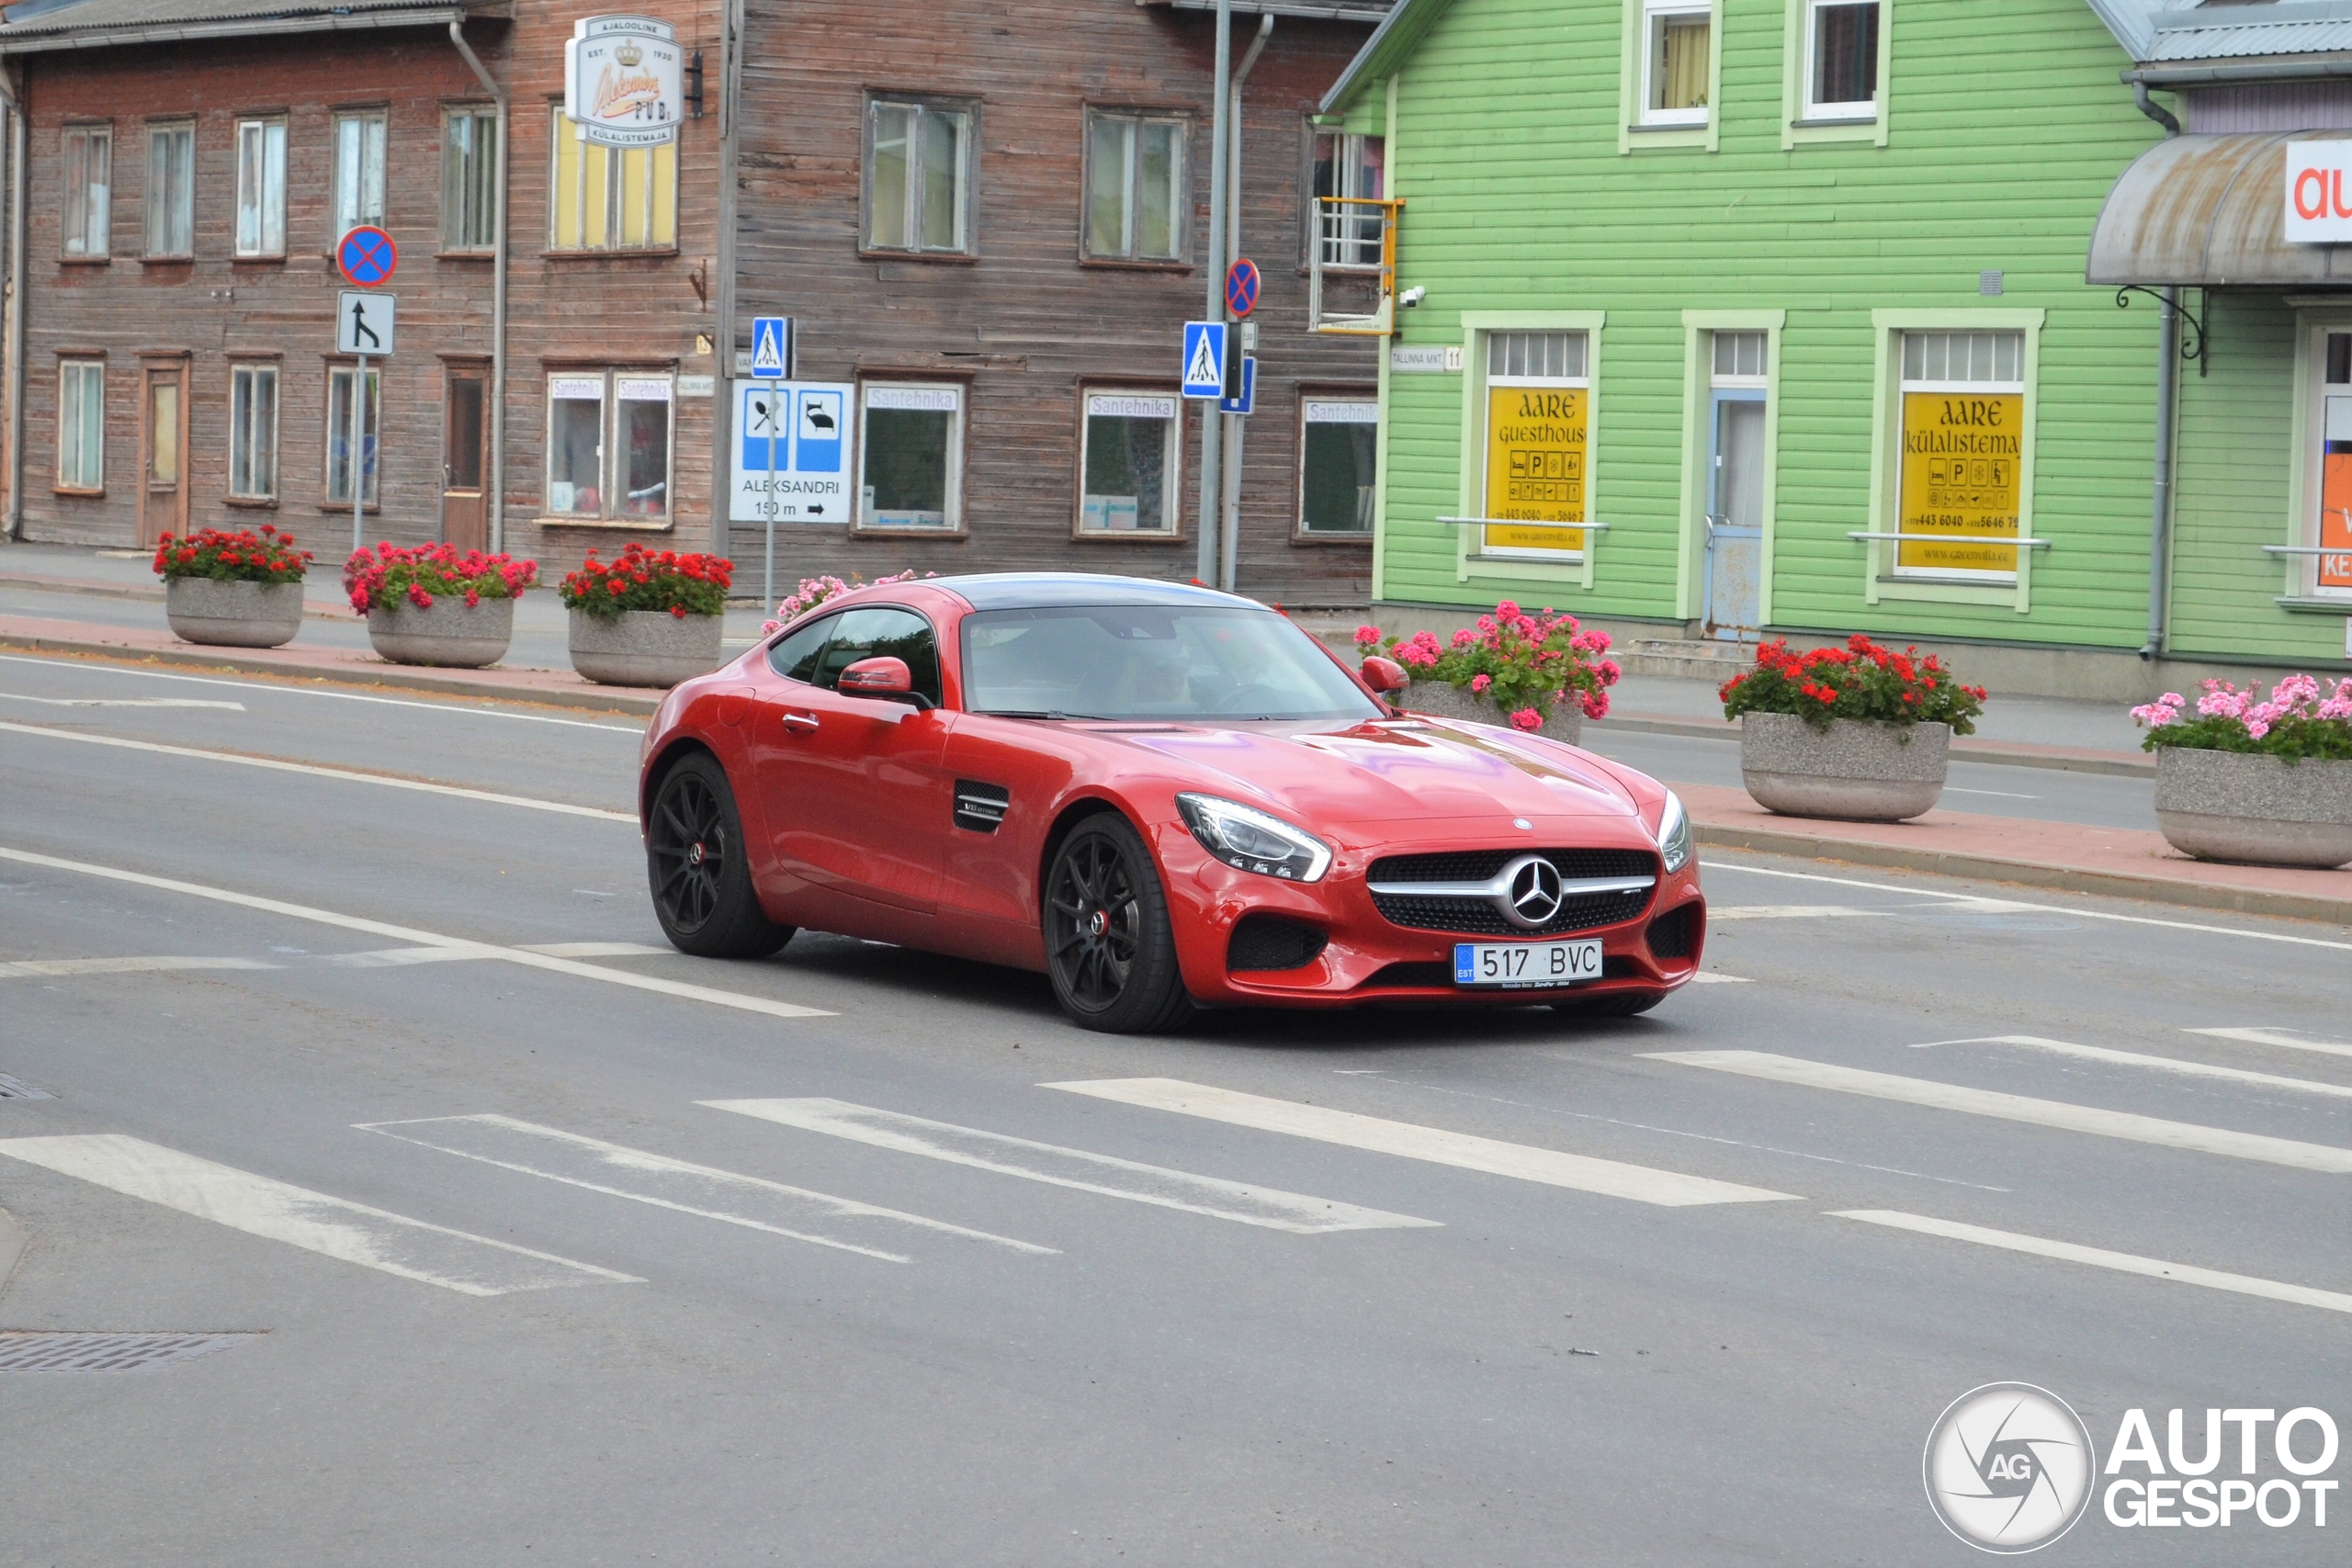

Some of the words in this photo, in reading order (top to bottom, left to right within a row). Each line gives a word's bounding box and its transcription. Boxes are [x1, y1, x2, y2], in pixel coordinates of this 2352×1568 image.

[603, 22, 658, 34] AJALOOLINE
[588, 49, 606, 59] EST.
[653, 50, 673, 62] 1930
[636, 100, 666, 120] PUB
[593, 129, 668, 142] KÜLALISTEMAJA
[2294, 167, 2352, 220] au
[1393, 353, 1424, 364] TALLINNA
[1449, 351, 1460, 367] 11
[555, 380, 599, 396] Santehnika
[621, 381, 667, 398] Santehnika
[873, 389, 953, 409] Santehnika
[1092, 397, 1170, 416] Santehnika
[742, 479, 840, 494] ALEKSANDRI
[755, 502, 779, 514] 150
[784, 504, 797, 515] m
[1939, 515, 1963, 526] 6040
[1484, 949, 1530, 976] 517
[1550, 945, 1597, 975] BVC
[1457, 969, 1474, 978] EST
